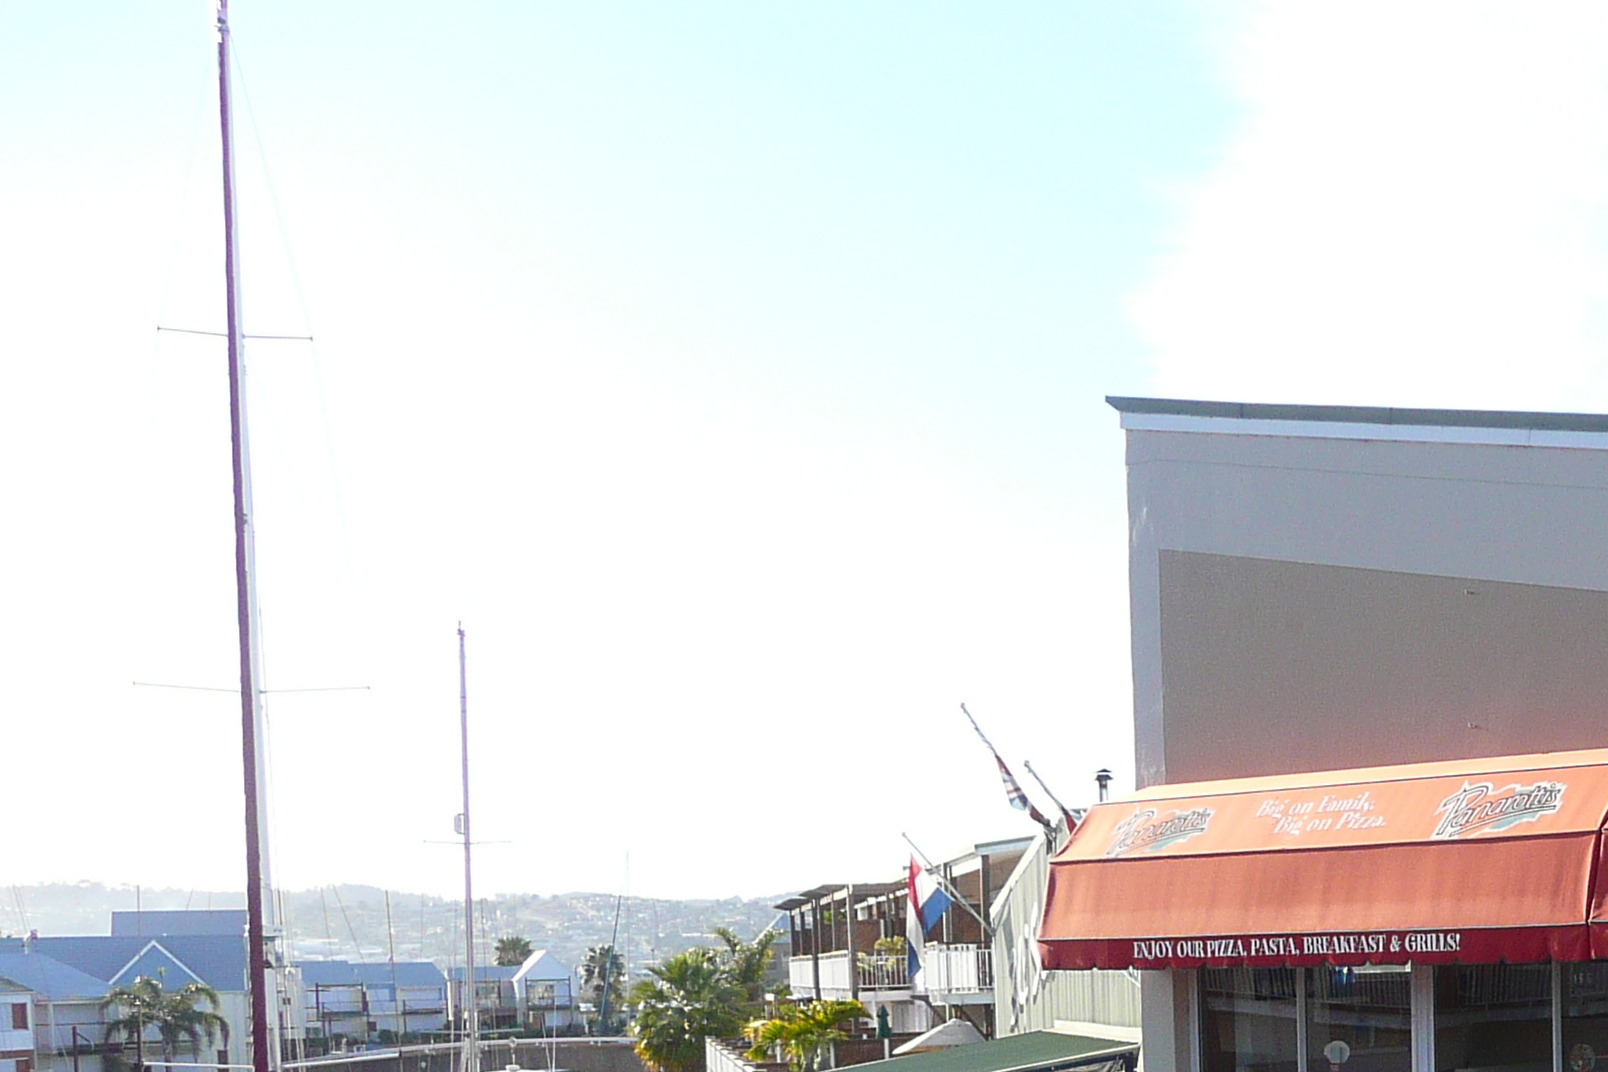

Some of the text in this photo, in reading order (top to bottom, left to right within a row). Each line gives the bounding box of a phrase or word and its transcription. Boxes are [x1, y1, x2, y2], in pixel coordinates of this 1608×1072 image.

[1256, 800, 1289, 822] Big
[1288, 801, 1314, 816] on
[1436, 784, 1559, 837] Panarottis
[1108, 806, 1211, 856] Panarottis
[1272, 812, 1386, 837] Big on Pizza.
[1133, 933, 1461, 959] ENJOY OUR PIZZA, PASTA, BREAKFAST & GRILLS!
